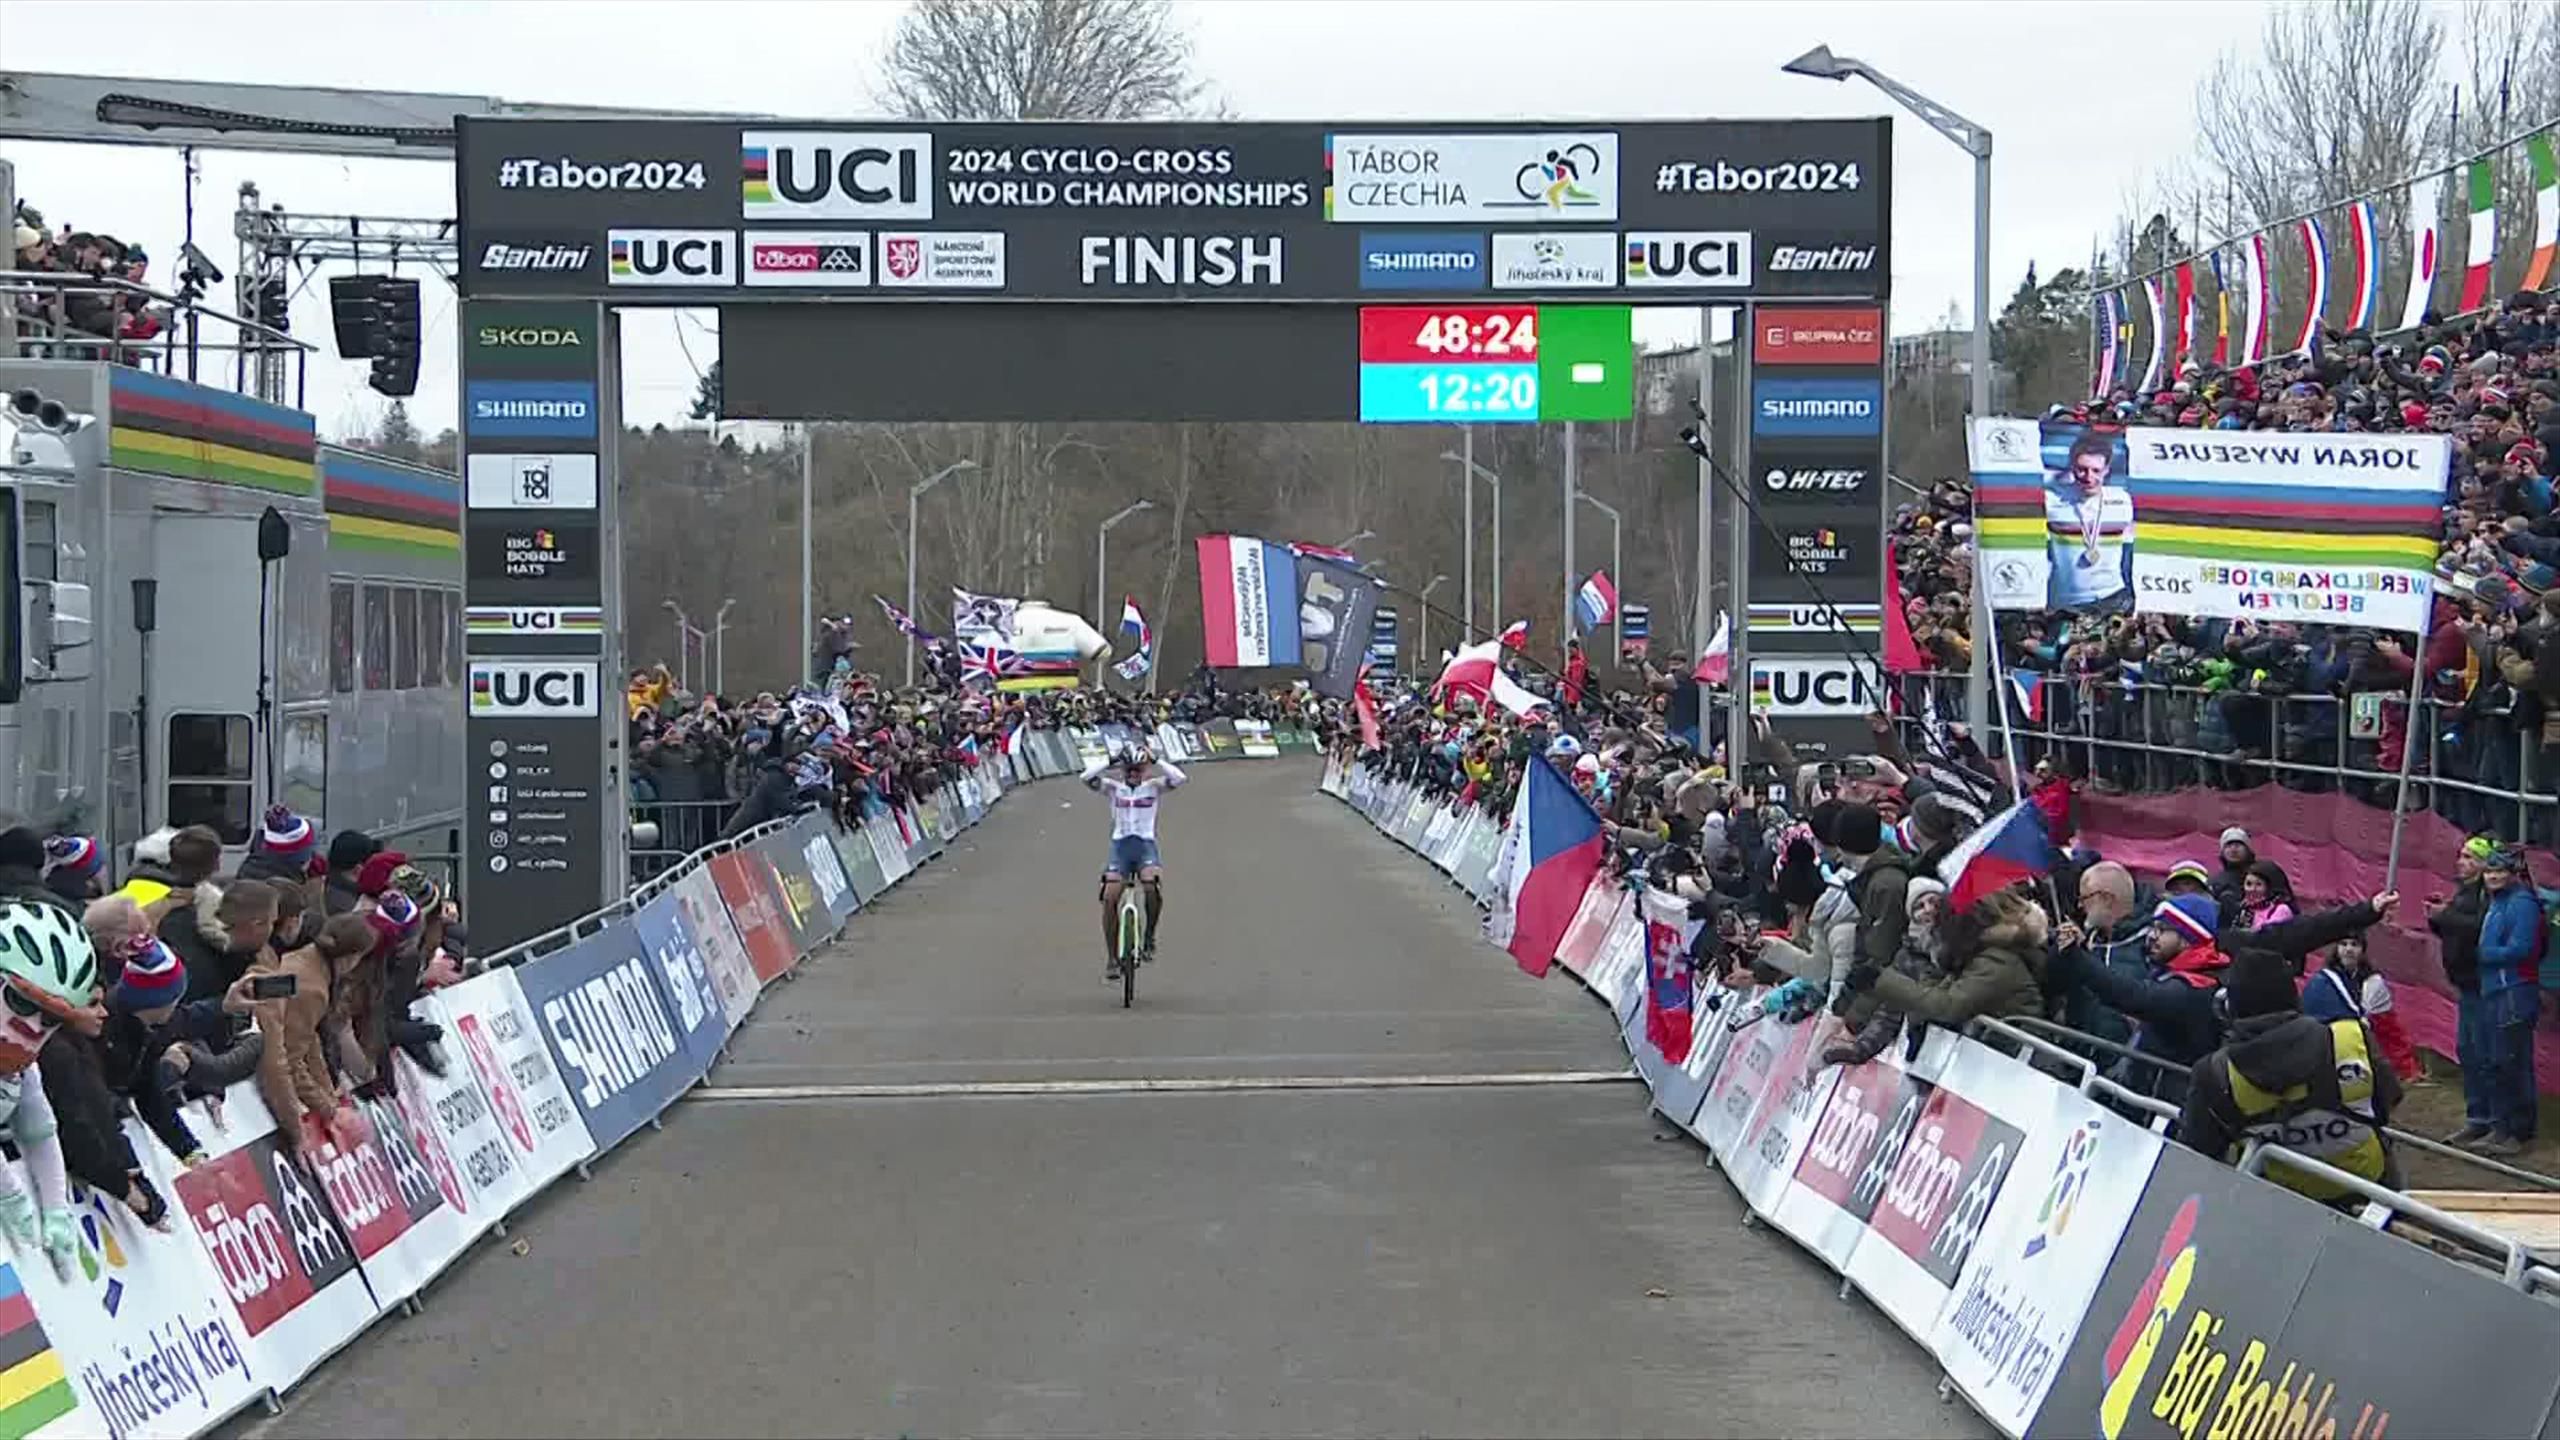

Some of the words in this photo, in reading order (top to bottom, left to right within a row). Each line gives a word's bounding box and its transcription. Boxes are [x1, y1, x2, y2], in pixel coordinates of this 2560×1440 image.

[948, 150, 1013, 173] 2024
[1020, 149, 1232, 173] CYCLO-CROSS
[1346, 144, 1439, 174] TÁBOR
[499, 159, 706, 190] #Tabor2024
[775, 148, 917, 204] UCI
[1656, 160, 1860, 190] #Tabor2024
[948, 182, 1057, 206] WORLD
[1063, 182, 1309, 207] CHAMPIONSHIPS
[1347, 182, 1467, 206] CZECHIA
[480, 244, 592, 268] Santini
[632, 240, 723, 275] UCI
[1082, 236, 1285, 285] FINISH
[1368, 251, 1475, 269] SHIMANO
[1650, 241, 1738, 276] UCI
[1769, 245, 1876, 270] Santini
[1415, 315, 1537, 354] 48:24
[1418, 374, 1536, 411] 12:20
[476, 400, 586, 418] SHIMANO
[1762, 400, 1871, 417] SHIMANO
[1788, 469, 1867, 490] HI-TEC
[506, 537, 532, 549] BIG
[506, 550, 566, 562] BOBBLE
[1789, 537, 1815, 548] BIG
[506, 564, 545, 575] HATS
[512, 612, 555, 628] UCI
[494, 671, 586, 707] UCI
[1773, 670, 1867, 706] UCI
[543, 957, 676, 1108] SHIMANO
[178, 1298, 252, 1382] kraj
[2151, 1309, 2225, 1440] Big
